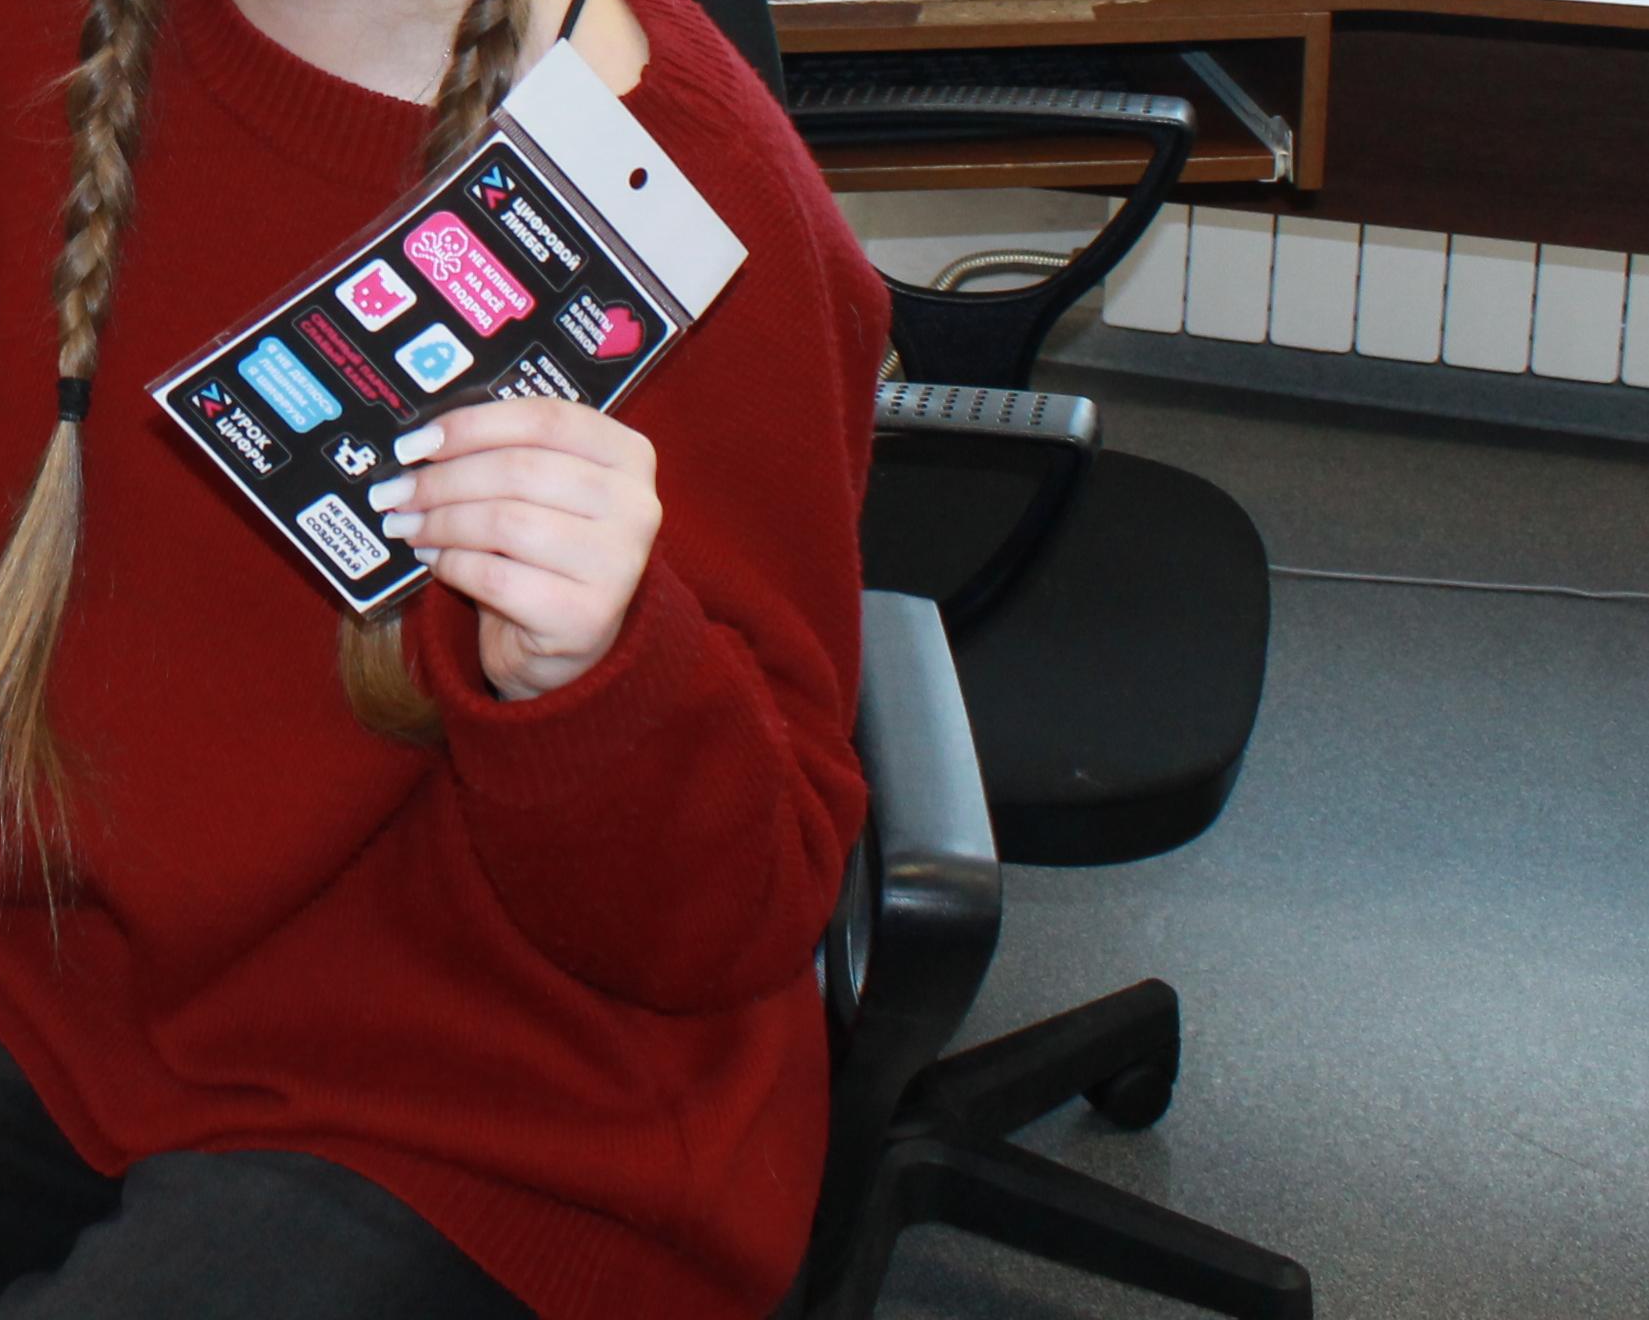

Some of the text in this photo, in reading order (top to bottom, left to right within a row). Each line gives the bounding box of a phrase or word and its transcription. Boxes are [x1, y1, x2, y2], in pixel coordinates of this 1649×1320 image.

[500, 210, 549, 262] ЛИКБЕЗ
[512, 197, 580, 271] ЦИФРОВОЙ
[464, 272, 505, 313] НА ВСЁ
[468, 249, 526, 310] НЕ КЛИКАЙ
[448, 280, 492, 328] ПОДРЯД
[569, 302, 606, 345] ВАЖНЕЕ
[581, 295, 613, 332] ФАКТЫ
[559, 313, 597, 354] ЛАЙКОВ
[259, 358, 307, 406] ЛИШНИМ
[266, 343, 333, 414] Я НЕ ДЕЛЮСЬ
[520, 360, 537, 376] ОТ
[536, 355, 580, 401] ПЕРЕРЫВ
[247, 366, 306, 425] Я ШИФРУЮ
[216, 417, 271, 473] ЦИФРЫ
[230, 407, 271, 449] УРОК
[305, 516, 360, 572] СОЗДАВАЙ
[318, 512, 359, 554] СМОТРИ
[326, 501, 381, 558] НЕ ПРОСТО
